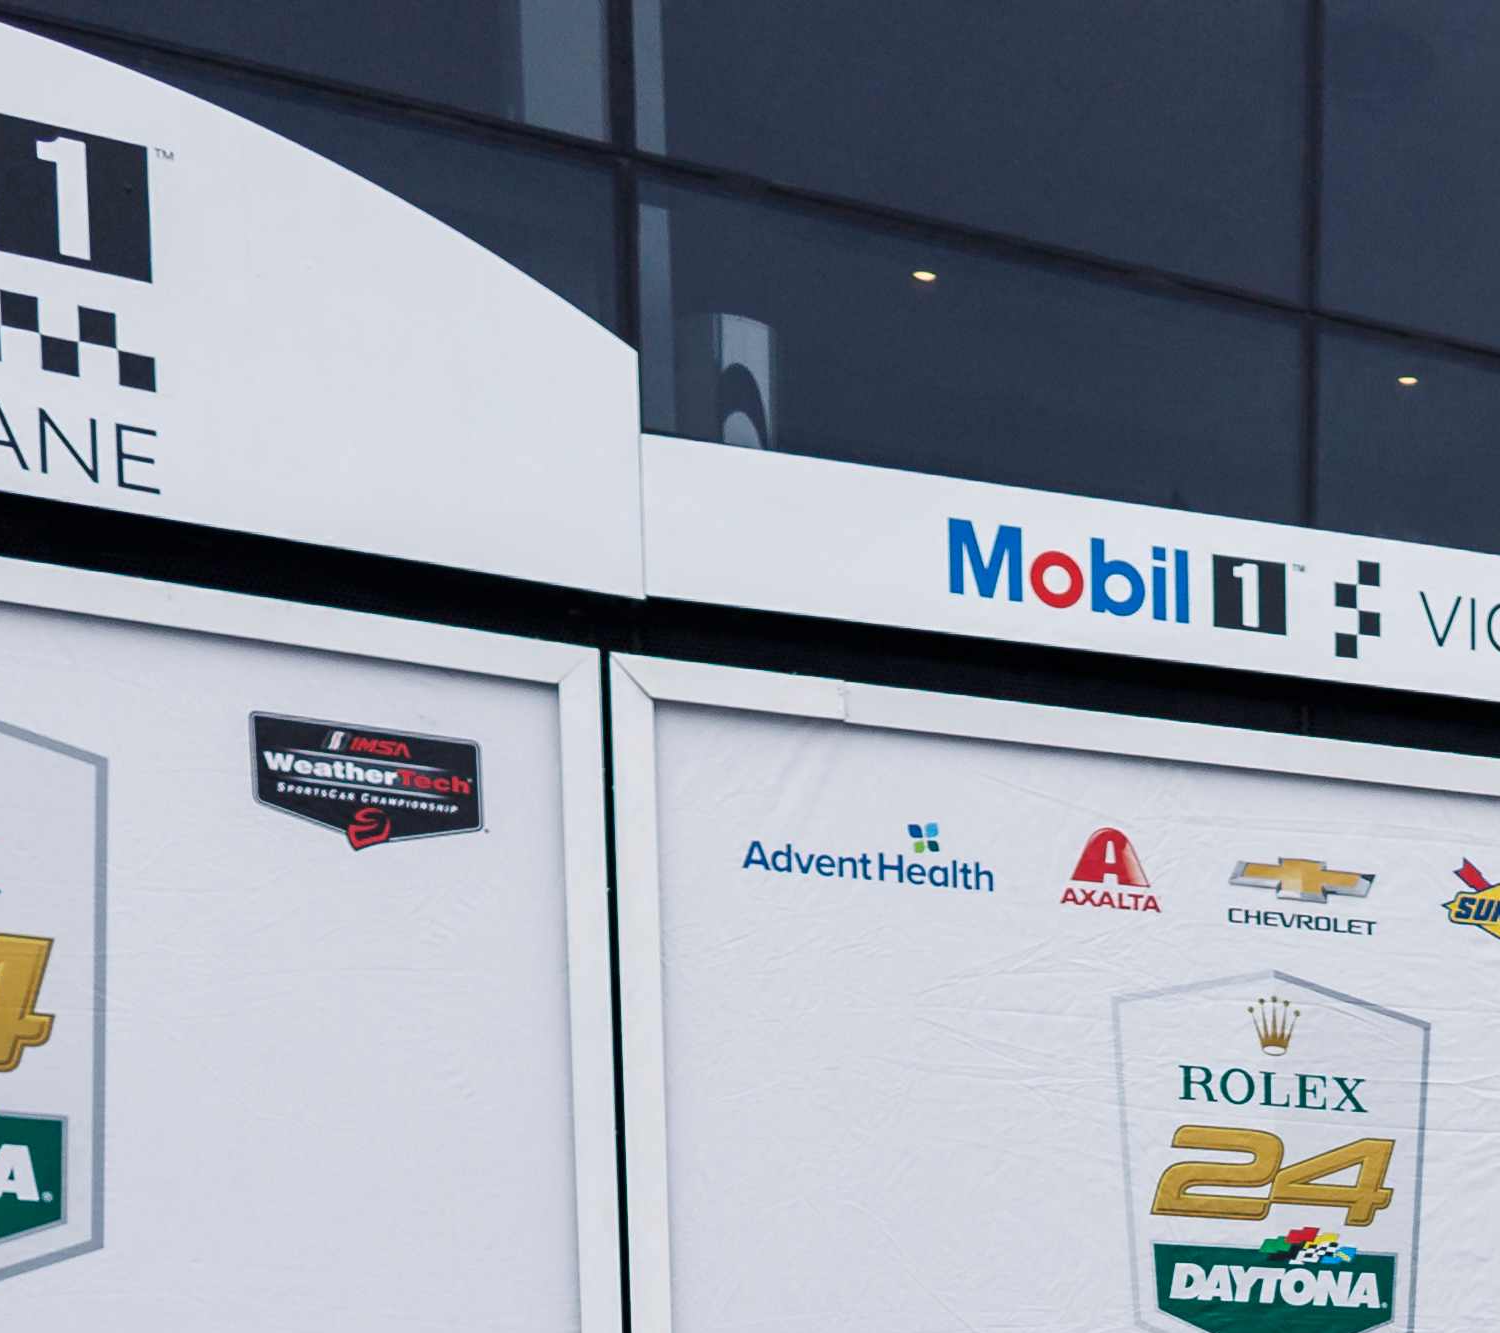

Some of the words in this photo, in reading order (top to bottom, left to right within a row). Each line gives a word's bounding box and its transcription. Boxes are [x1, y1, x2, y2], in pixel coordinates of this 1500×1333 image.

[947, 517, 1190, 624] Mobil
[350, 736, 412, 759] IMSA
[263, 751, 470, 795] WeatherTech
[1059, 887, 1162, 914] AXALTA
[1228, 907, 1377, 936] CHEVROLET
[1177, 1064, 1368, 1114] ROLEX
[1150, 1124, 1396, 1227] 24
[1169, 1262, 1381, 1310] DAYTONA
